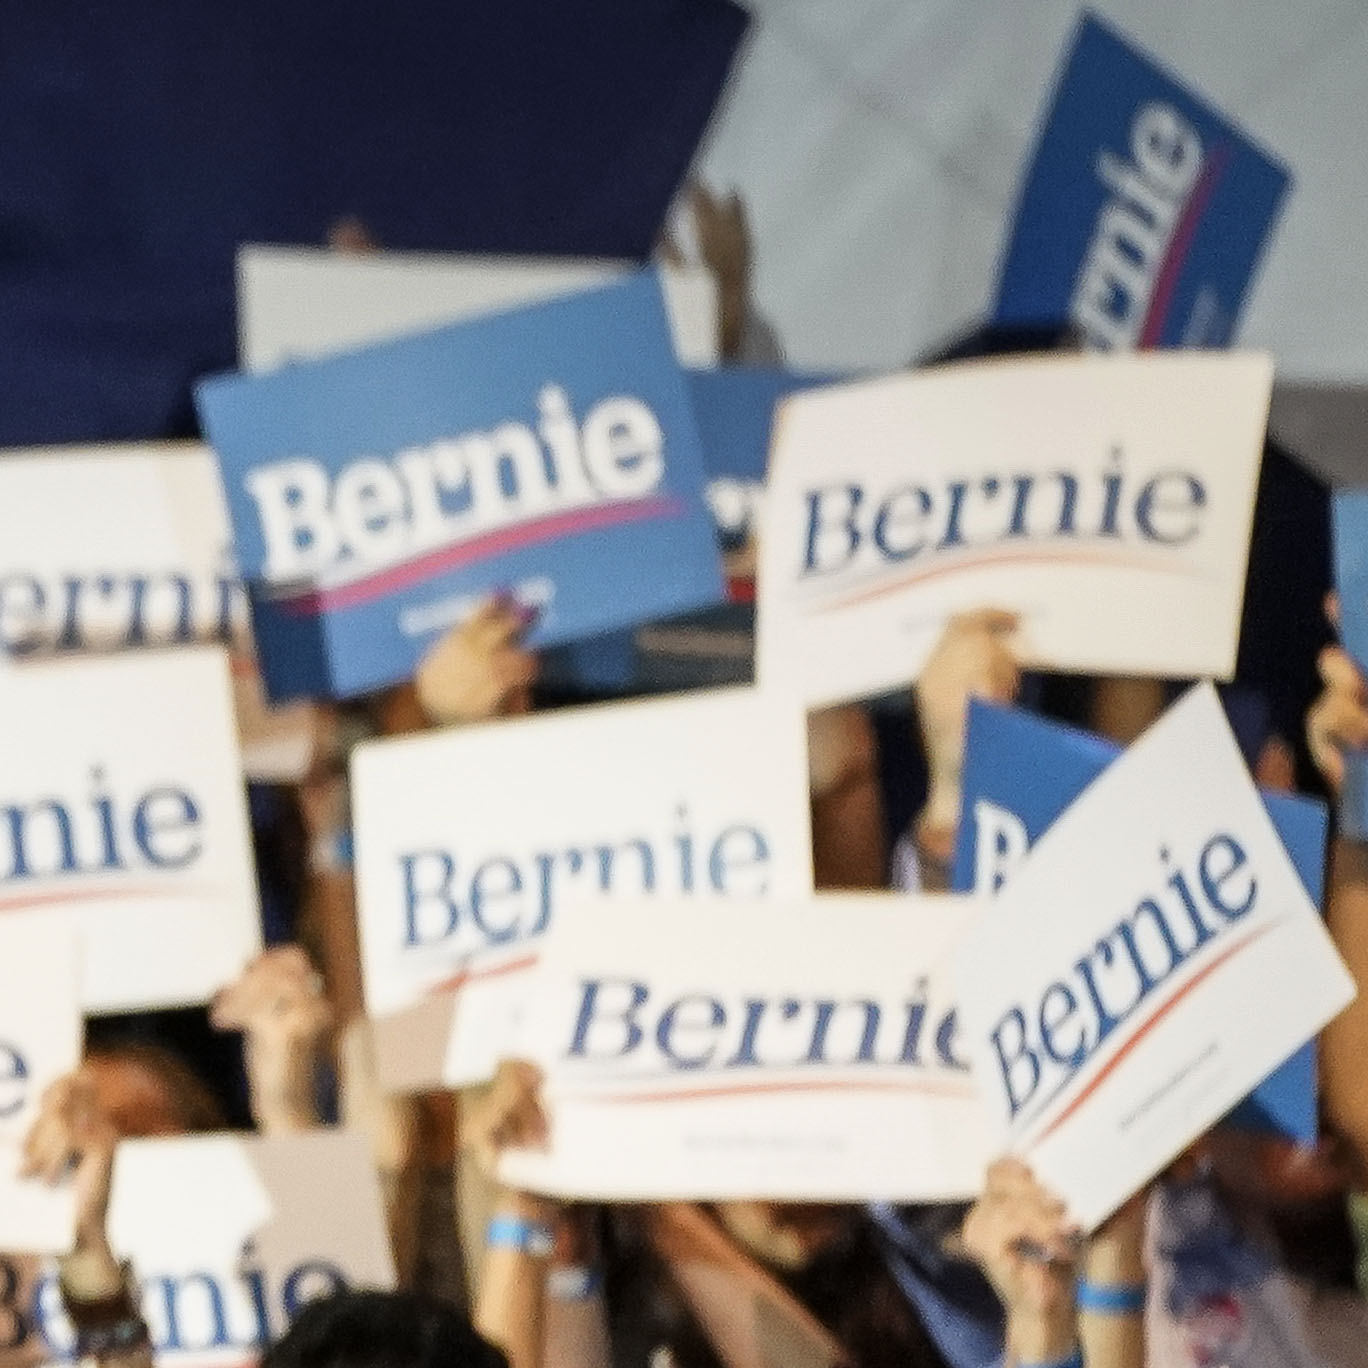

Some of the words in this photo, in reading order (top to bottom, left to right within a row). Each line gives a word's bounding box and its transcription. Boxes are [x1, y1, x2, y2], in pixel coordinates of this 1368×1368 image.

[245, 384, 666, 582] Bernie
[798, 443, 1207, 581] Bernie
[990, 830, 1258, 1120] Bernie
